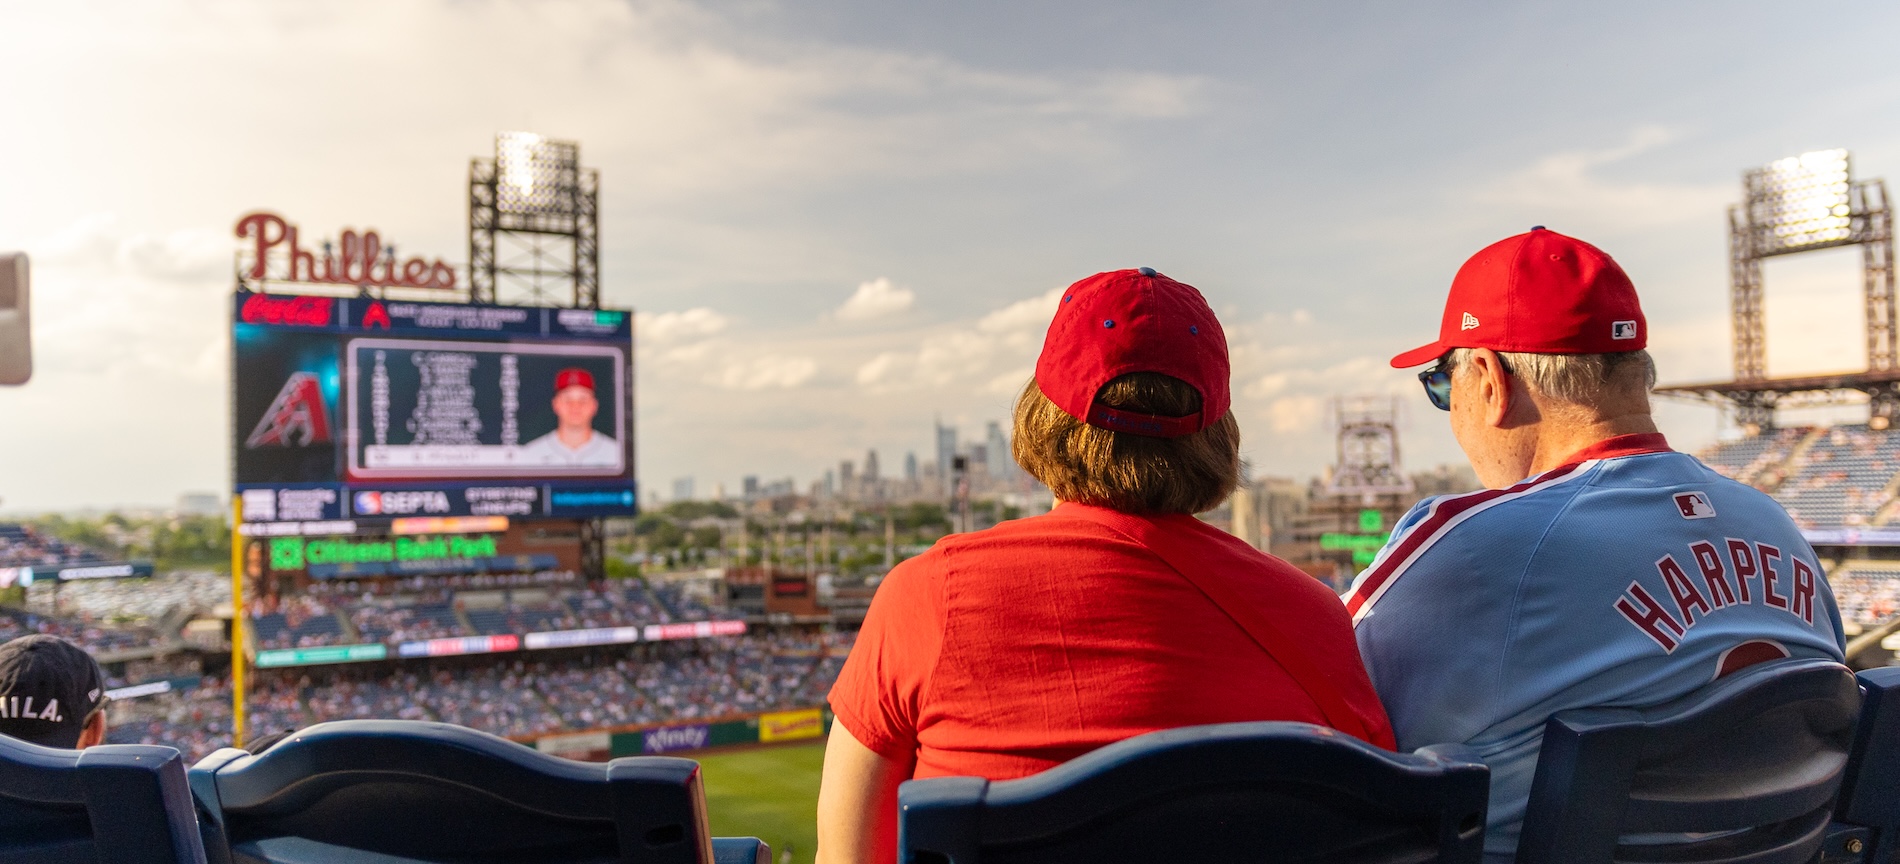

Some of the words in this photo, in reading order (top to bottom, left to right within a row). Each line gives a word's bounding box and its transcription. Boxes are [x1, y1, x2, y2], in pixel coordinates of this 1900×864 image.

[235, 212, 456, 289] Phillies
[381, 491, 449, 513] SEPTA
[306, 540, 393, 564] Citizens
[396, 536, 448, 560] Bank
[451, 535, 497, 558] Park
[1612, 537, 1816, 655] HARPER
[646, 727, 708, 752] xfinity
